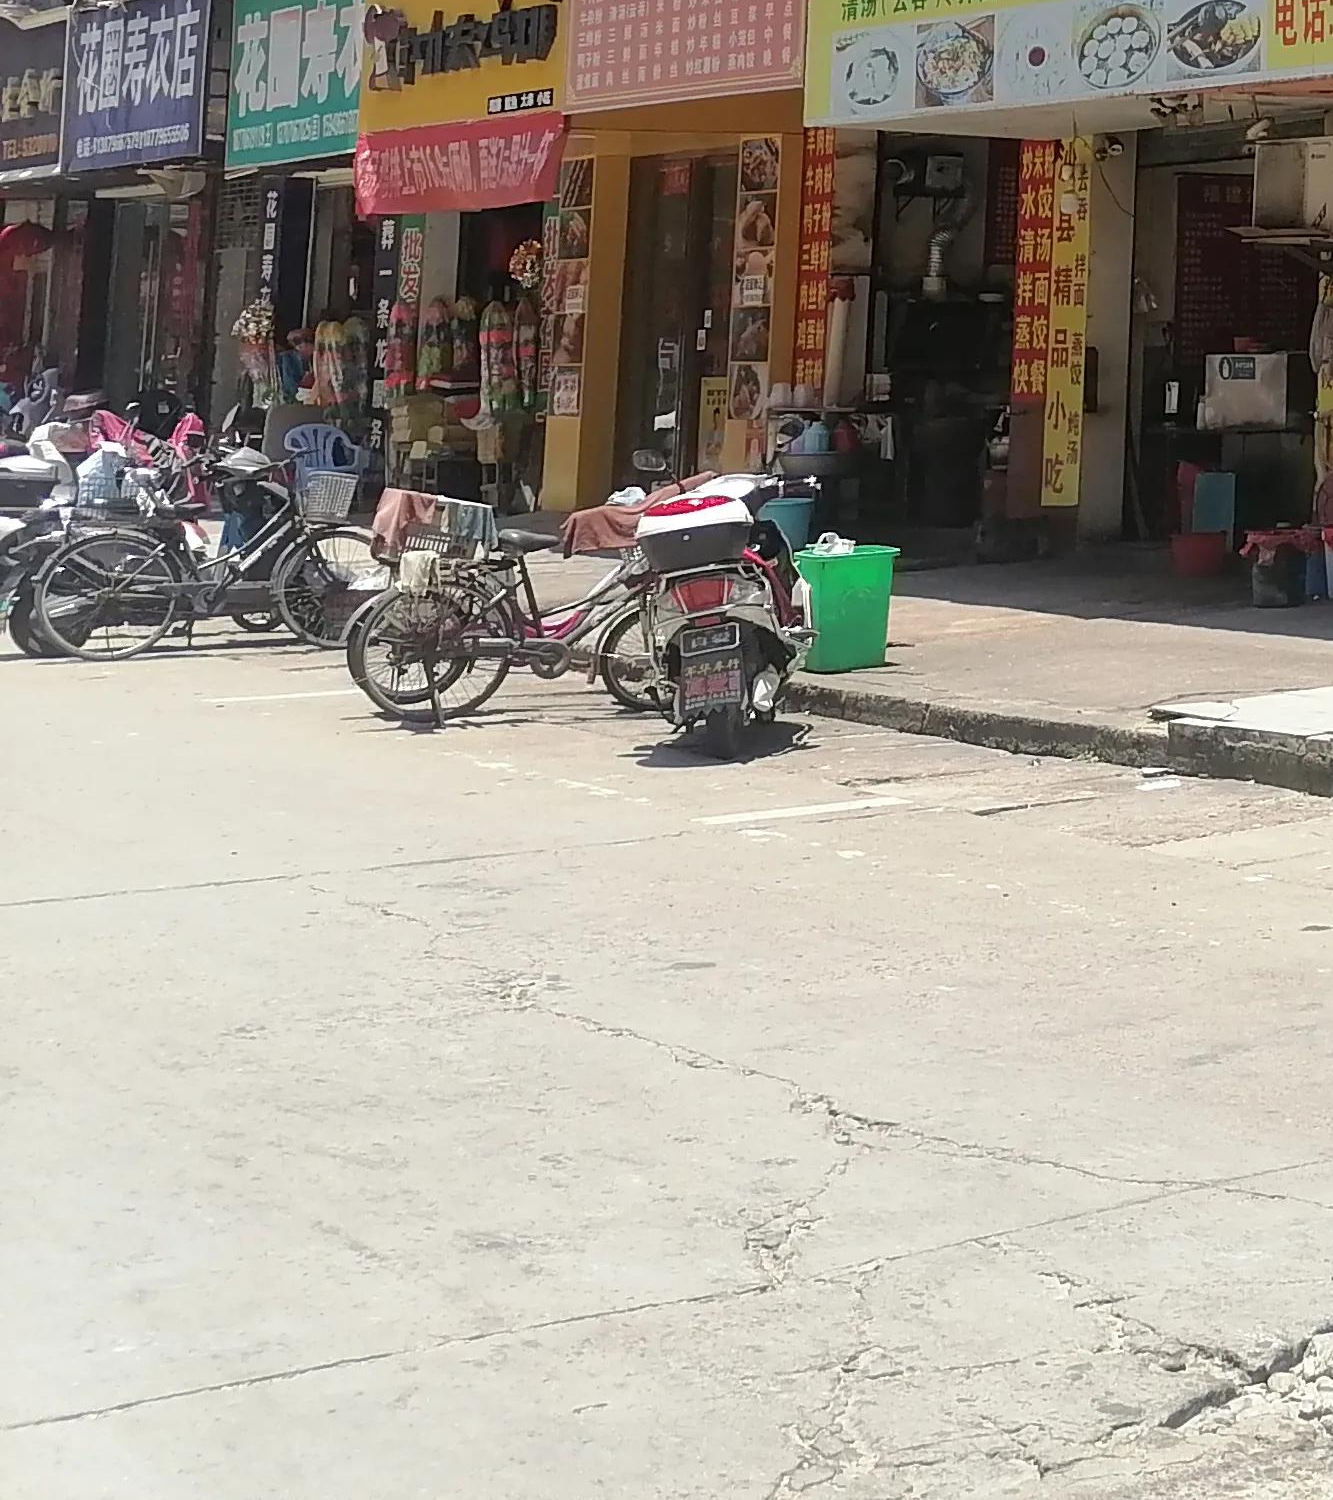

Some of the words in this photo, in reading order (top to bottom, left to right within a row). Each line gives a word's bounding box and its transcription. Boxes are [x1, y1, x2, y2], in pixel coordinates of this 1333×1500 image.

[1021, 185, 1052, 220] 水饺
[1019, 228, 1051, 263] 清汤
[1017, 272, 1050, 307] 拌面
[1015, 315, 1048, 351] 蒸饺
[1013, 358, 1046, 395] 快餐
